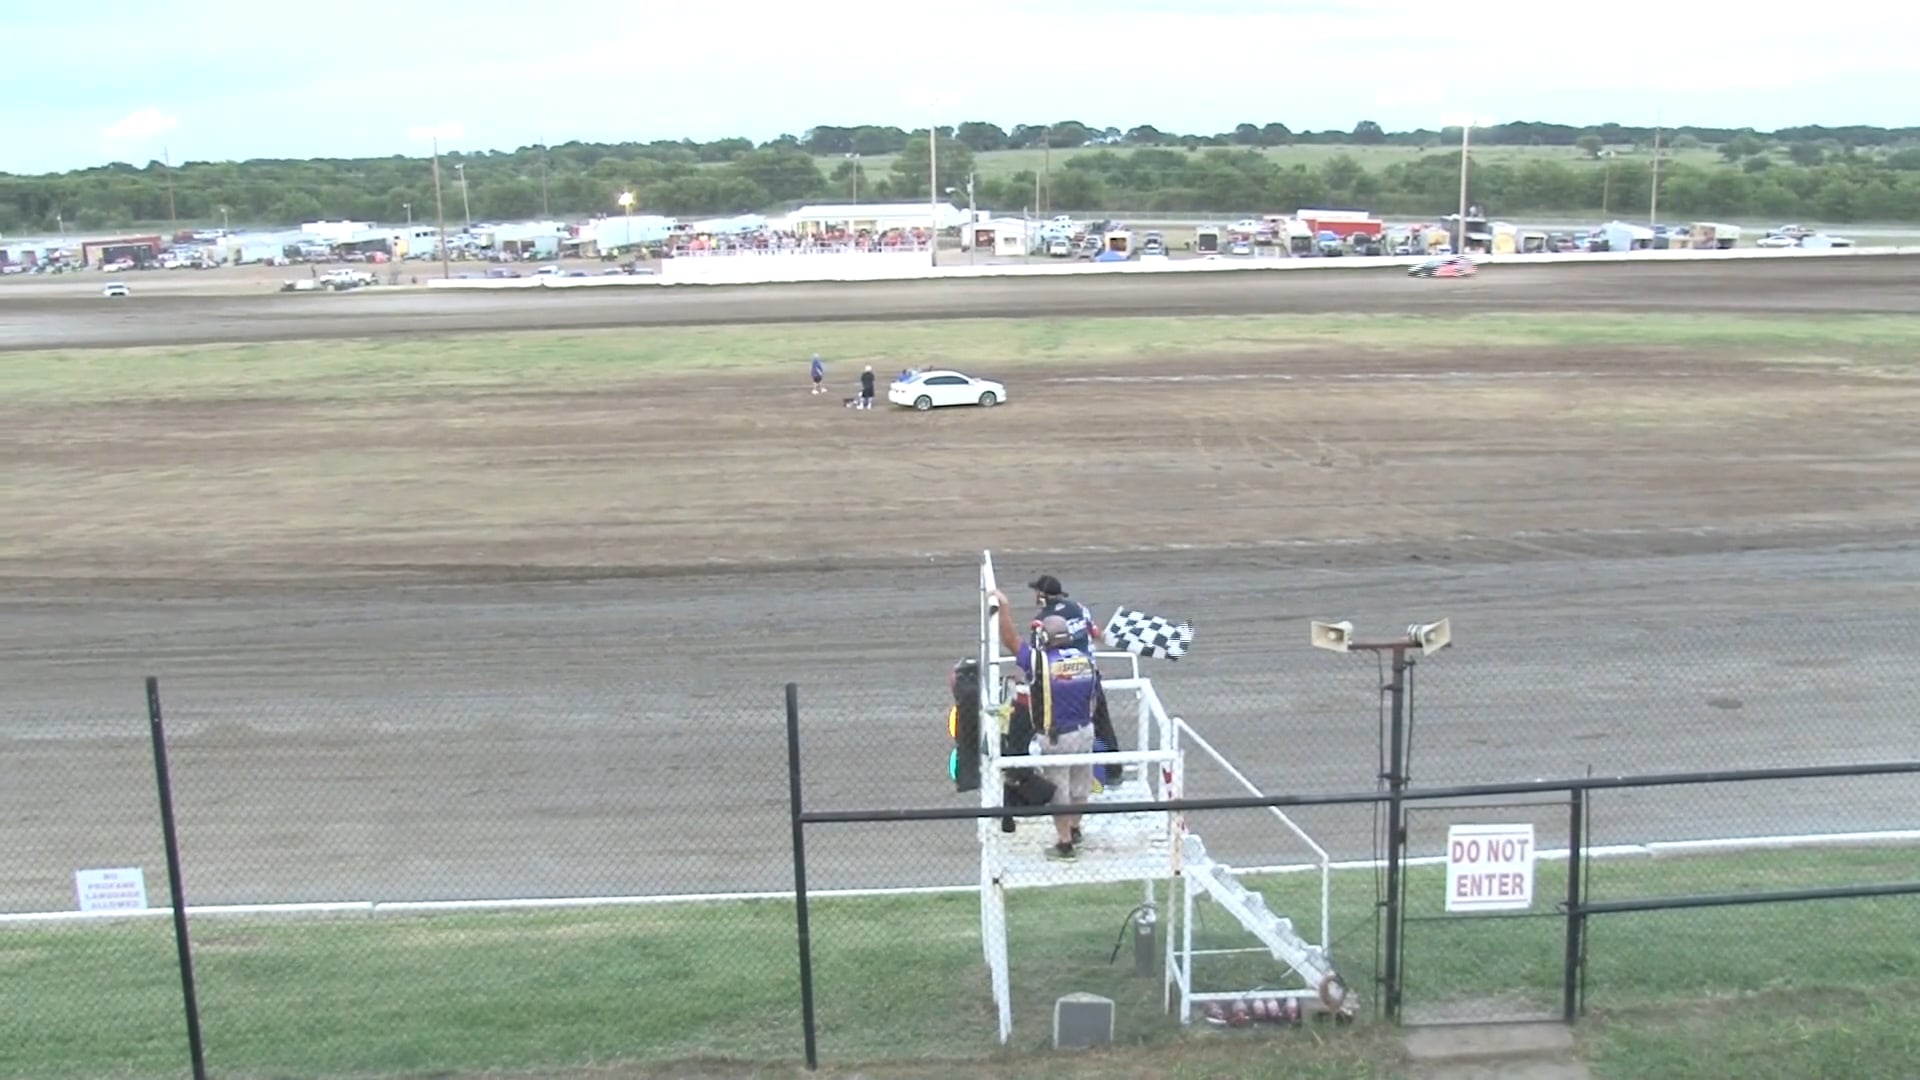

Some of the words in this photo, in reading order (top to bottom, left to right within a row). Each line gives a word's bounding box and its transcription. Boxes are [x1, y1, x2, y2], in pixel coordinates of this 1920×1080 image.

[1452, 839, 1480, 863] DO
[1487, 838, 1529, 862] NOT
[1457, 873, 1524, 897] ENTER
